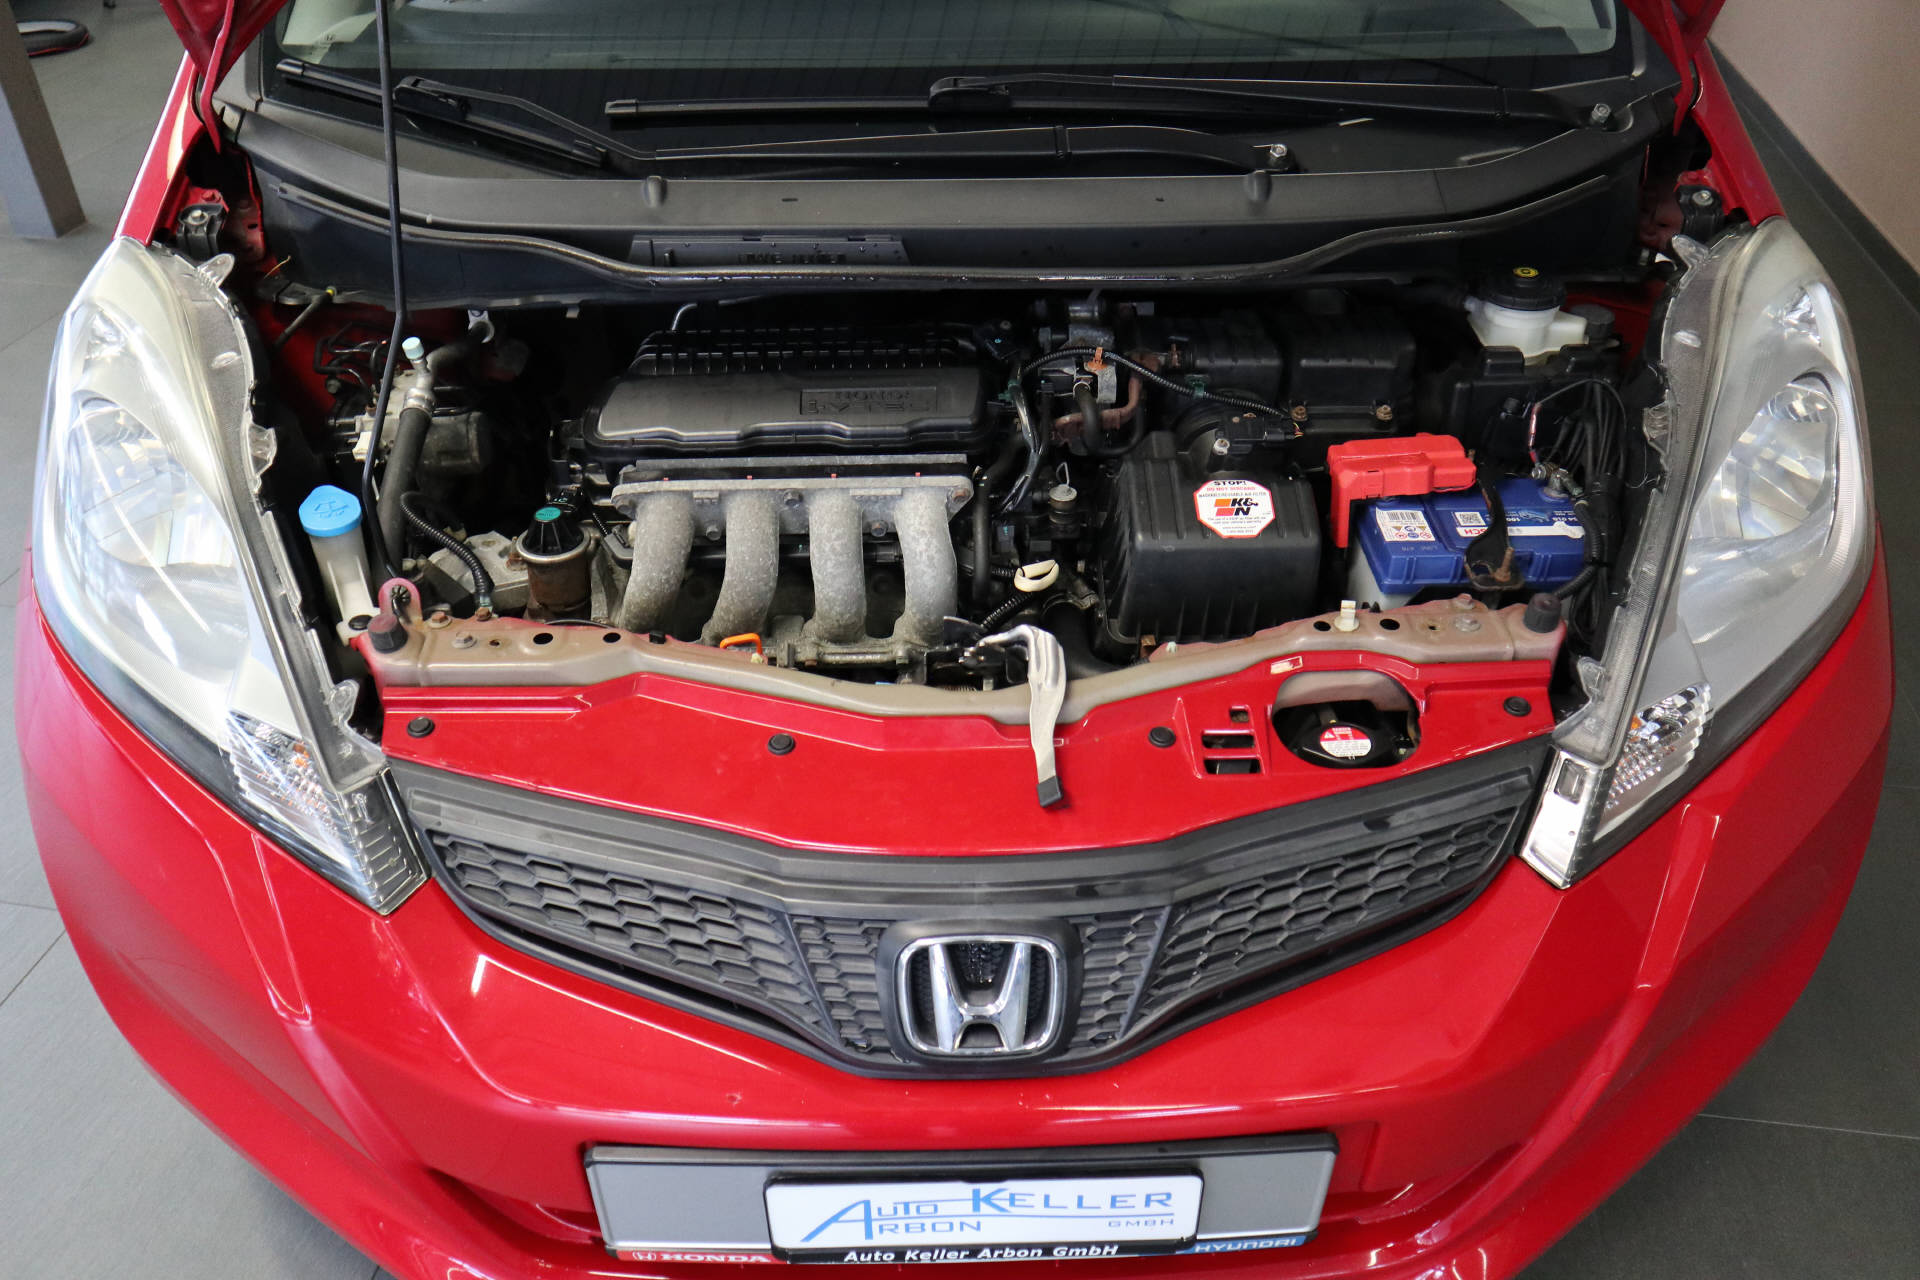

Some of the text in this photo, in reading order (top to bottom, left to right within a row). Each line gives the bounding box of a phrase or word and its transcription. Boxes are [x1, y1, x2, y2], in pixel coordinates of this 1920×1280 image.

[972, 1188, 1173, 1214] KELLER
[1194, 1237, 1298, 1253] HYUNDAI
[660, 1252, 772, 1263] HONDA
[843, 1245, 1119, 1263] Auto Keller Arbon GmbH
